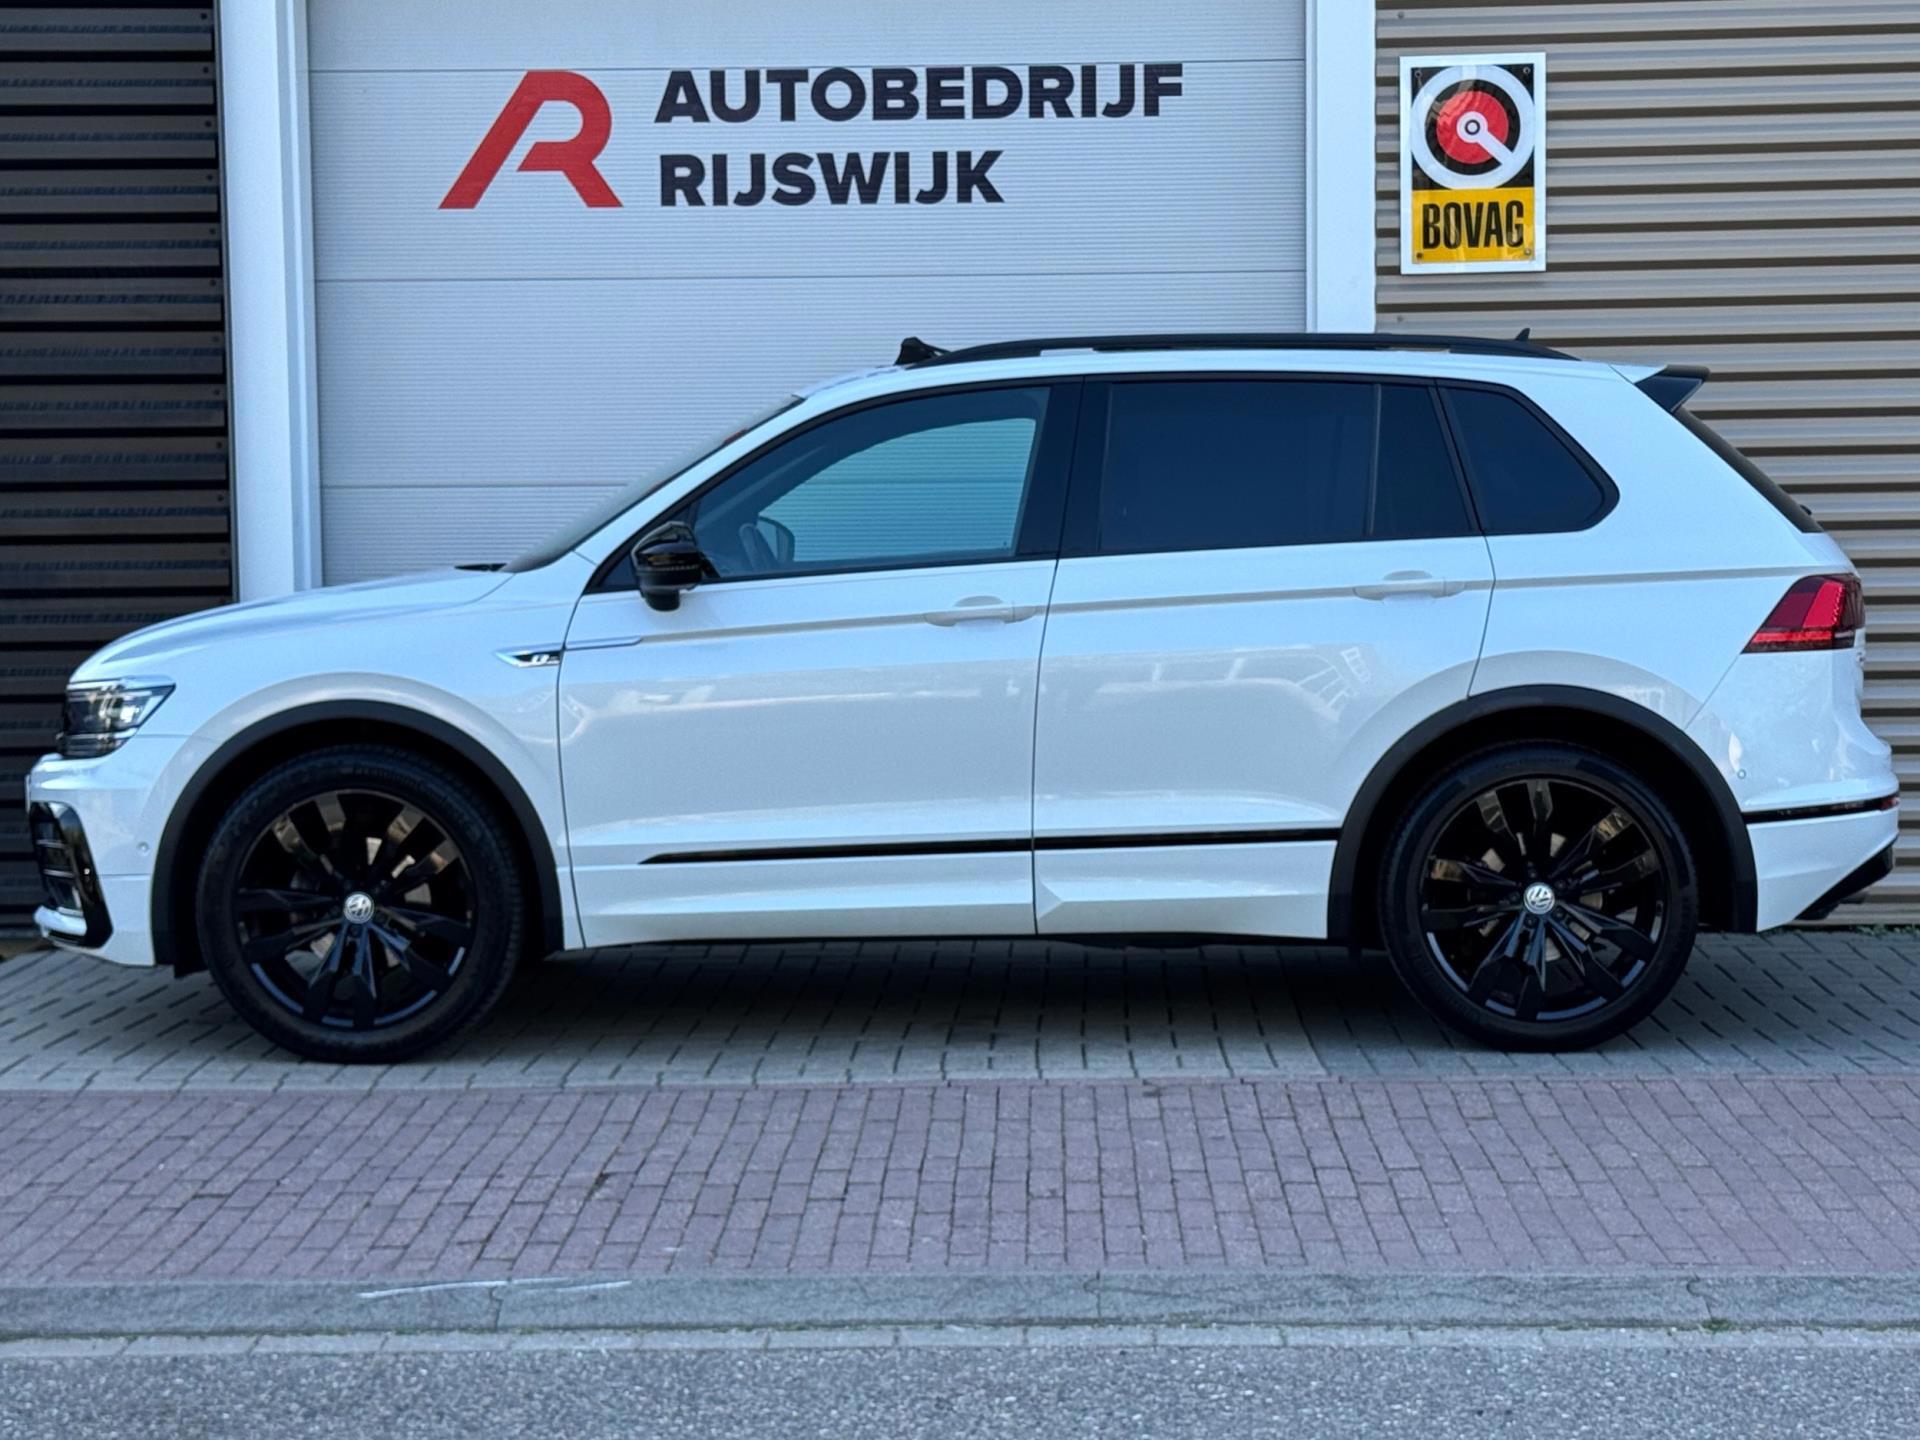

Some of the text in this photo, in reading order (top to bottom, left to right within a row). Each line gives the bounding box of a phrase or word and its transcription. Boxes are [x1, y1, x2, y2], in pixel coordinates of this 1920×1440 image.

[654, 63, 1184, 123] AUTOBEDRIJF
[660, 150, 1005, 207] RIJSWIJK
[1422, 200, 1525, 249] BOVAG
